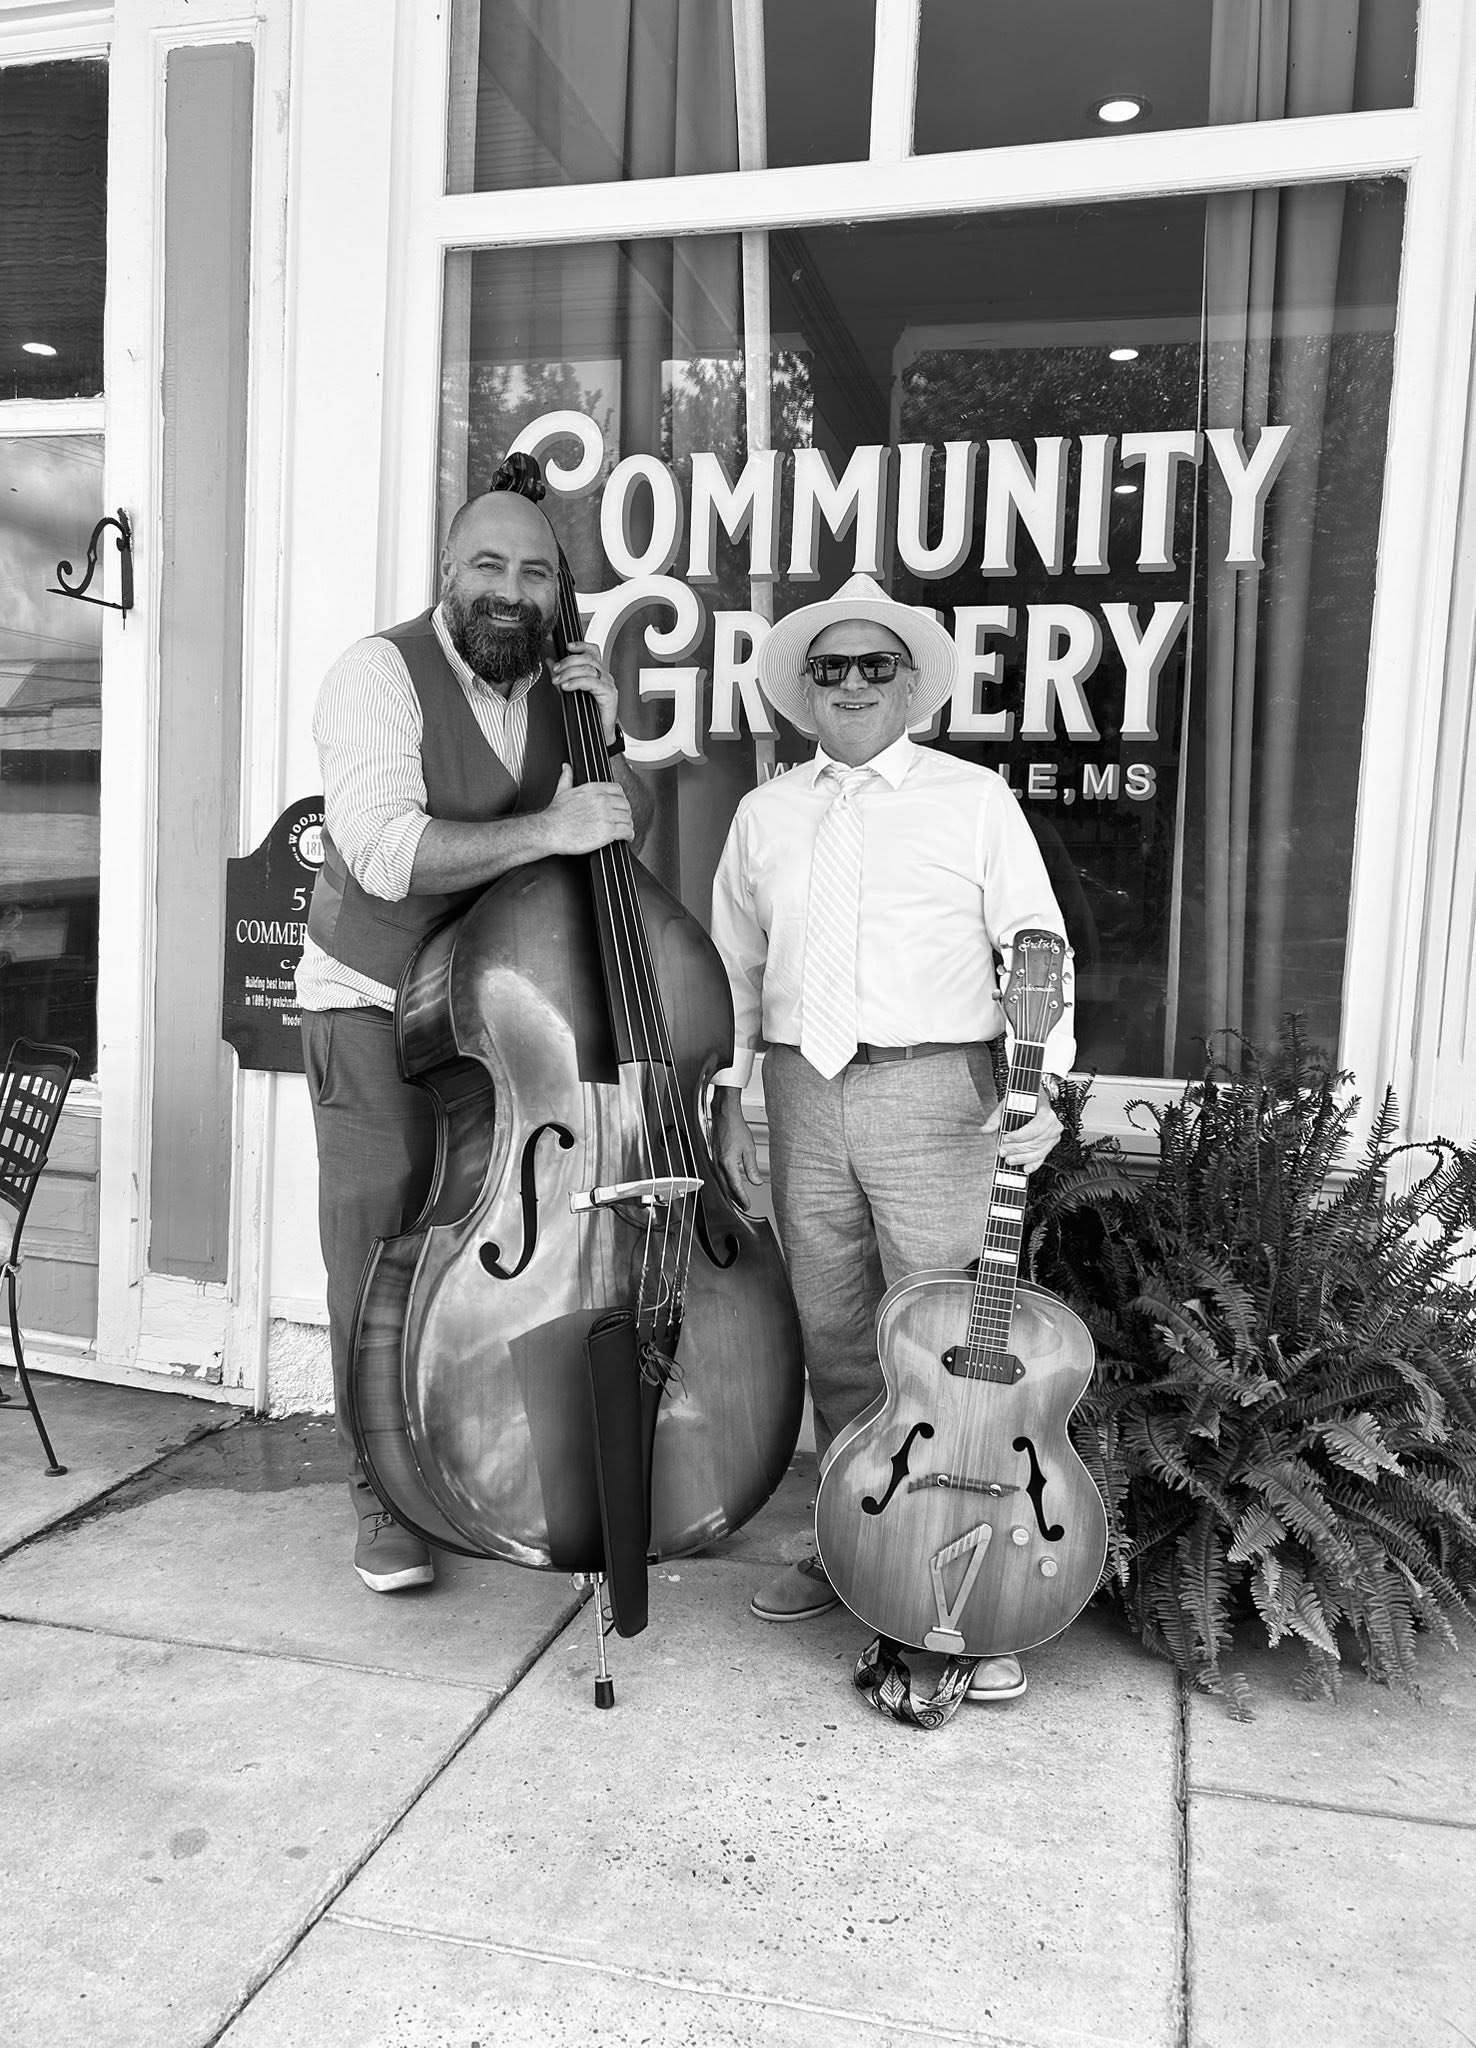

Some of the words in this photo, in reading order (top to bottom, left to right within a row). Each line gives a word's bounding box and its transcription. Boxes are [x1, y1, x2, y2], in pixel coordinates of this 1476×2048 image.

[575, 574, 1192, 768] GRERY
[245, 975, 265, 991] Building
[266, 977, 278, 989] best
[278, 978, 294, 990] known
[265, 995, 272, 1009] by
